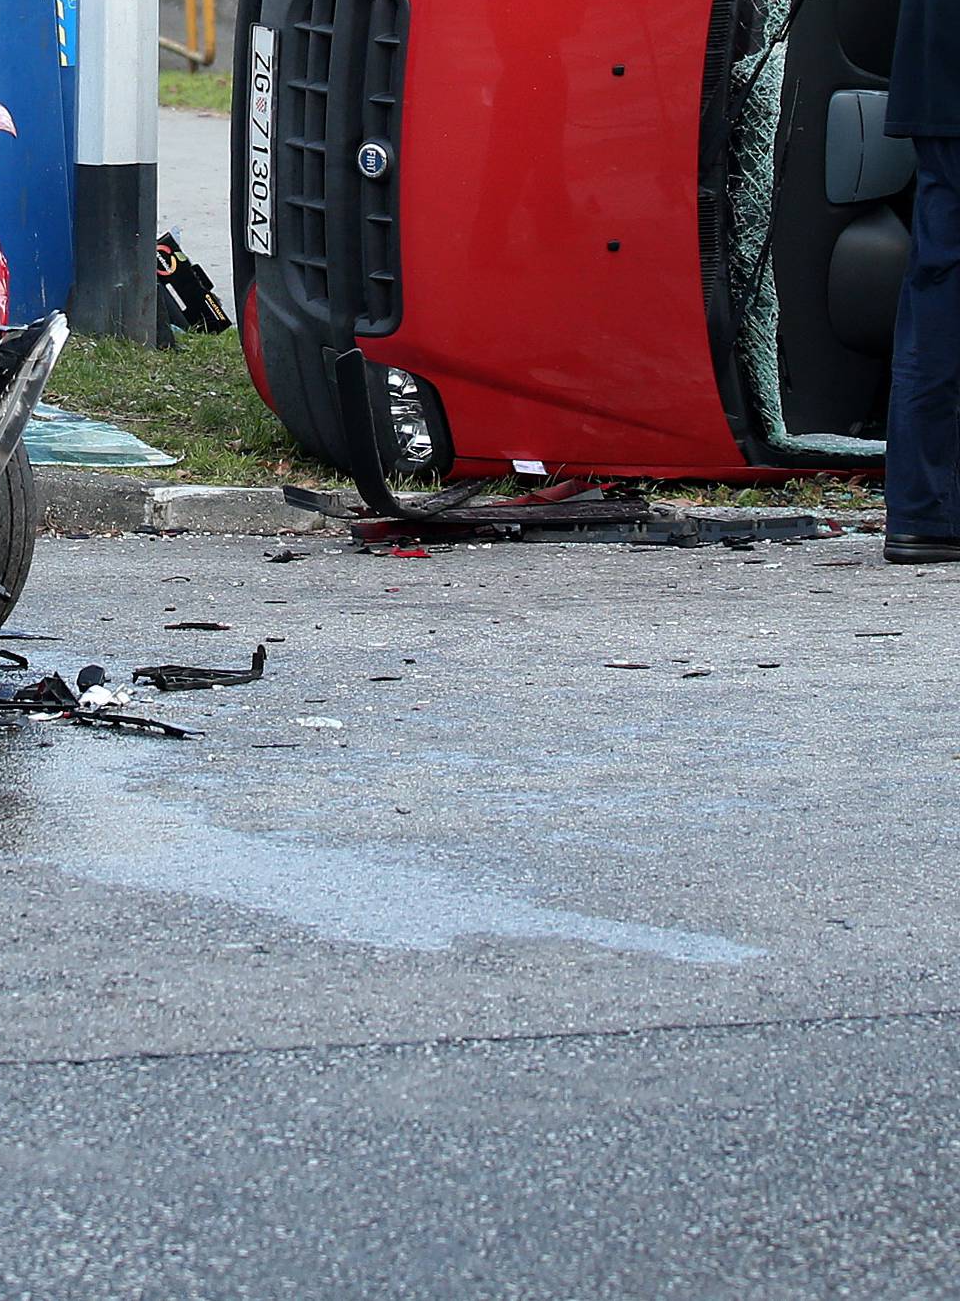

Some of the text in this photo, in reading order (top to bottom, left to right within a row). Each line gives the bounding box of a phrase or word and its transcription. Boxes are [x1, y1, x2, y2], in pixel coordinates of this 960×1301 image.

[251, 51, 271, 251] ZG 7130-AZ
[366, 149, 377, 172] FIAT
